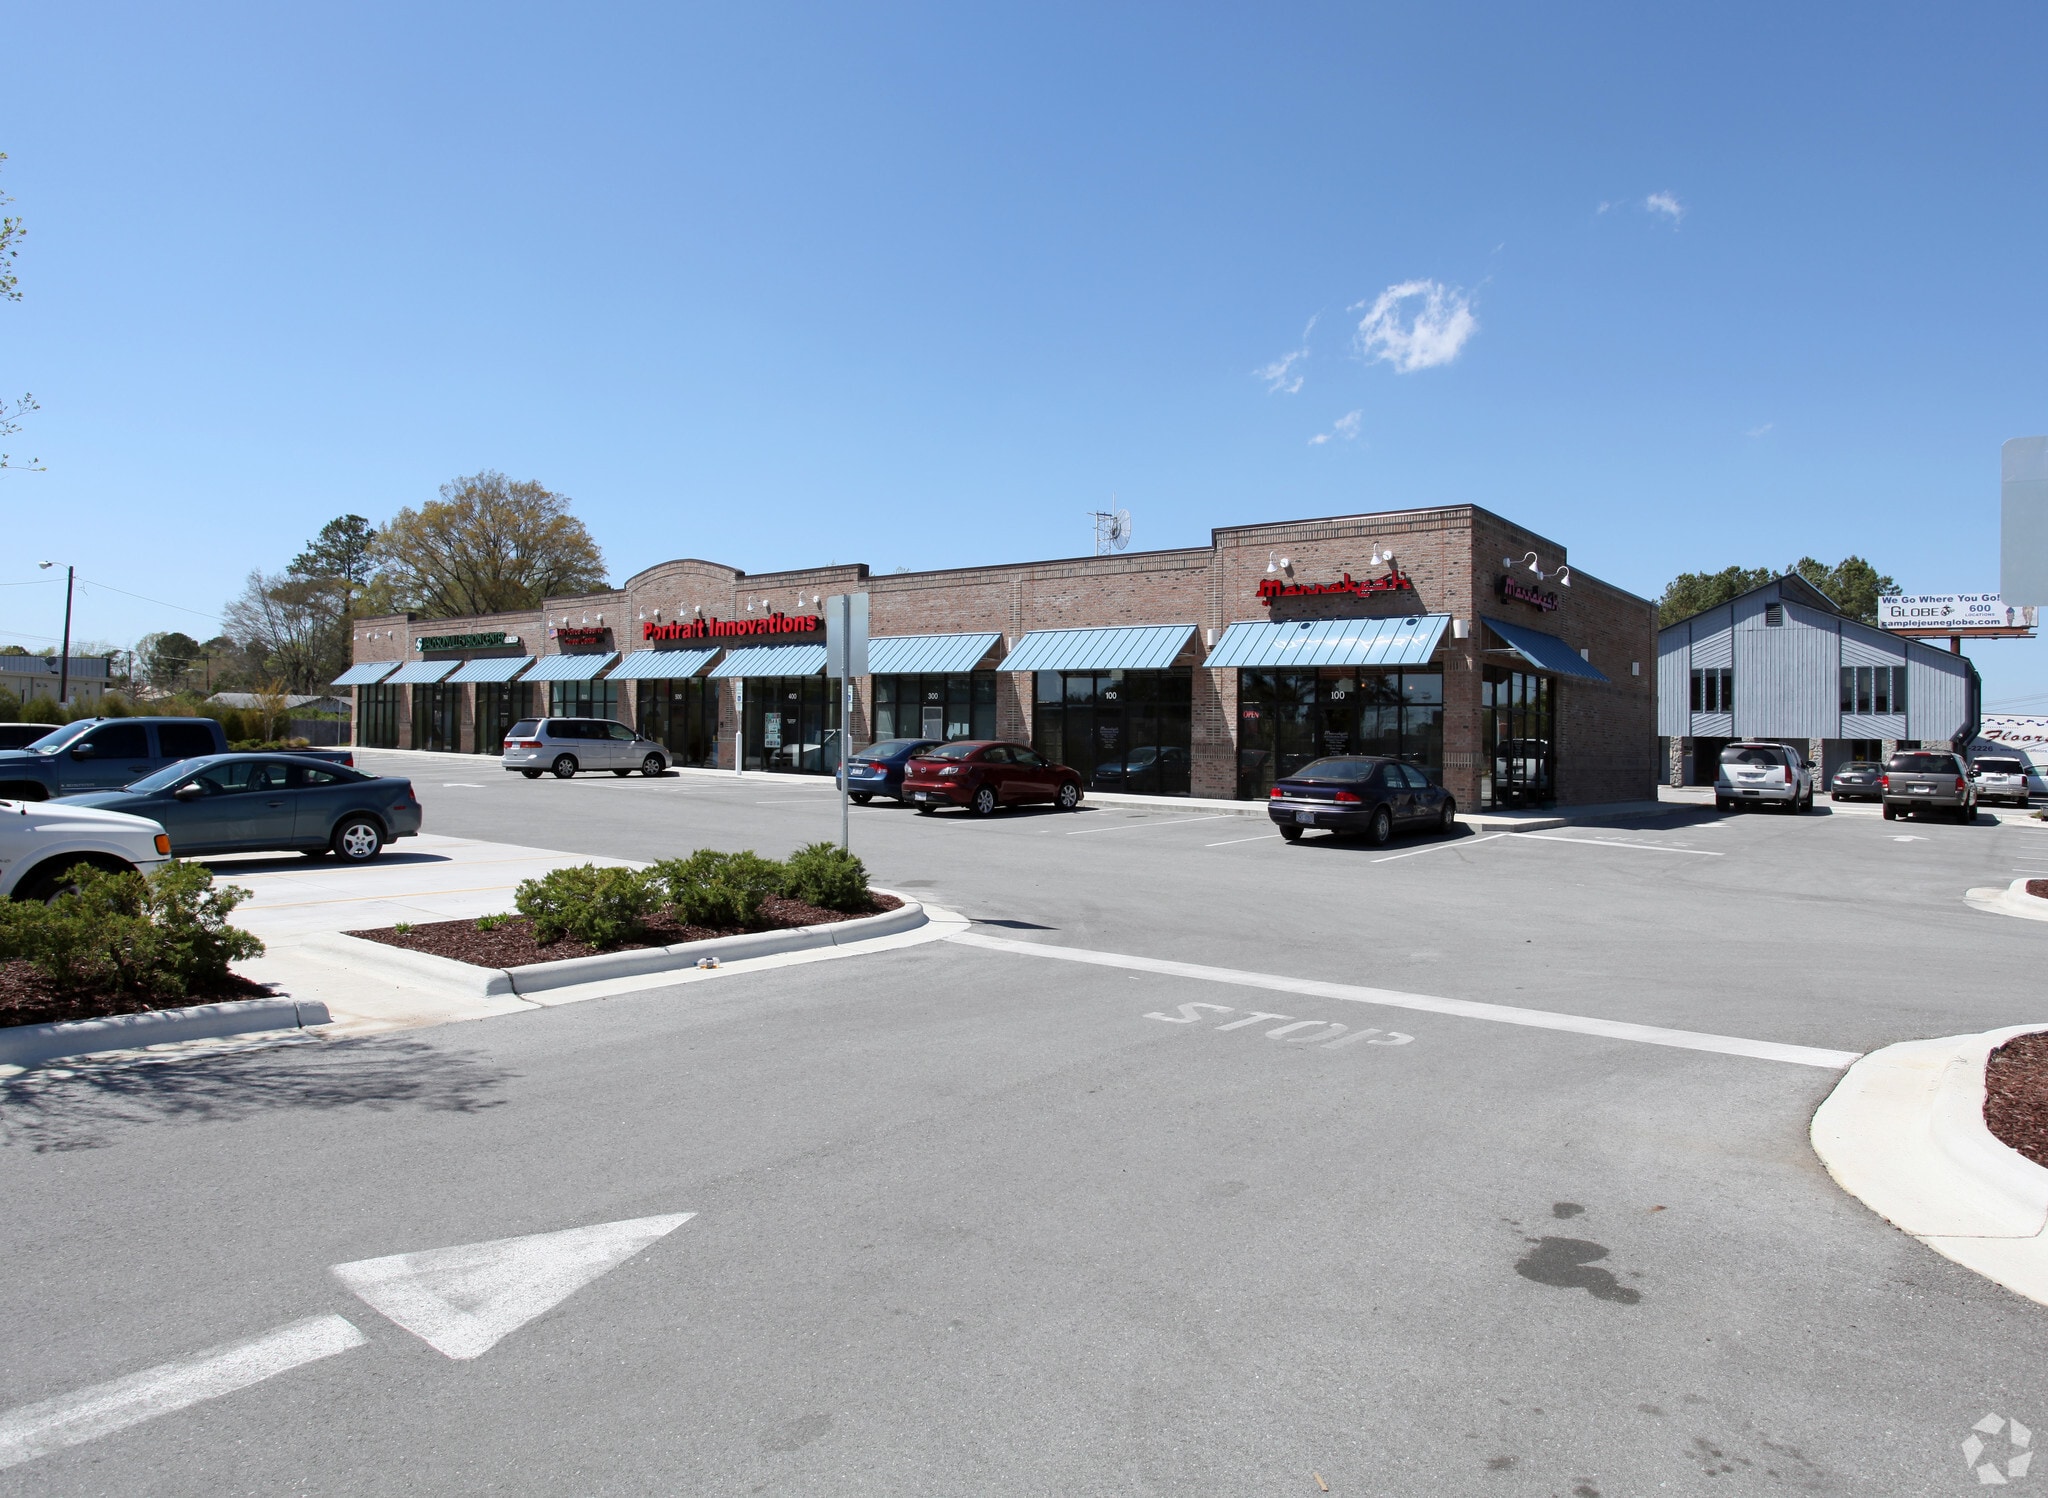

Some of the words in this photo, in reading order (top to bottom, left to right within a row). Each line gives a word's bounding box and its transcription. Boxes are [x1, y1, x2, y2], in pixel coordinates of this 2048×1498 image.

[1256, 569, 1411, 606] Marrakesh
[1919, 595, 1954, 603] Where
[1890, 605, 1940, 618] GLOBE
[1968, 604, 1991, 612] 600
[643, 618, 705, 641] Portrait
[709, 612, 818, 637] Innovations
[1881, 619, 2000, 628] camplejeuneglobe.com
[928, 692, 939, 700] 300
[1105, 691, 1117, 700] 100
[1331, 690, 1345, 700] 100
[1243, 710, 1260, 719] OPEN
[1142, 1001, 1415, 1049] STOP
